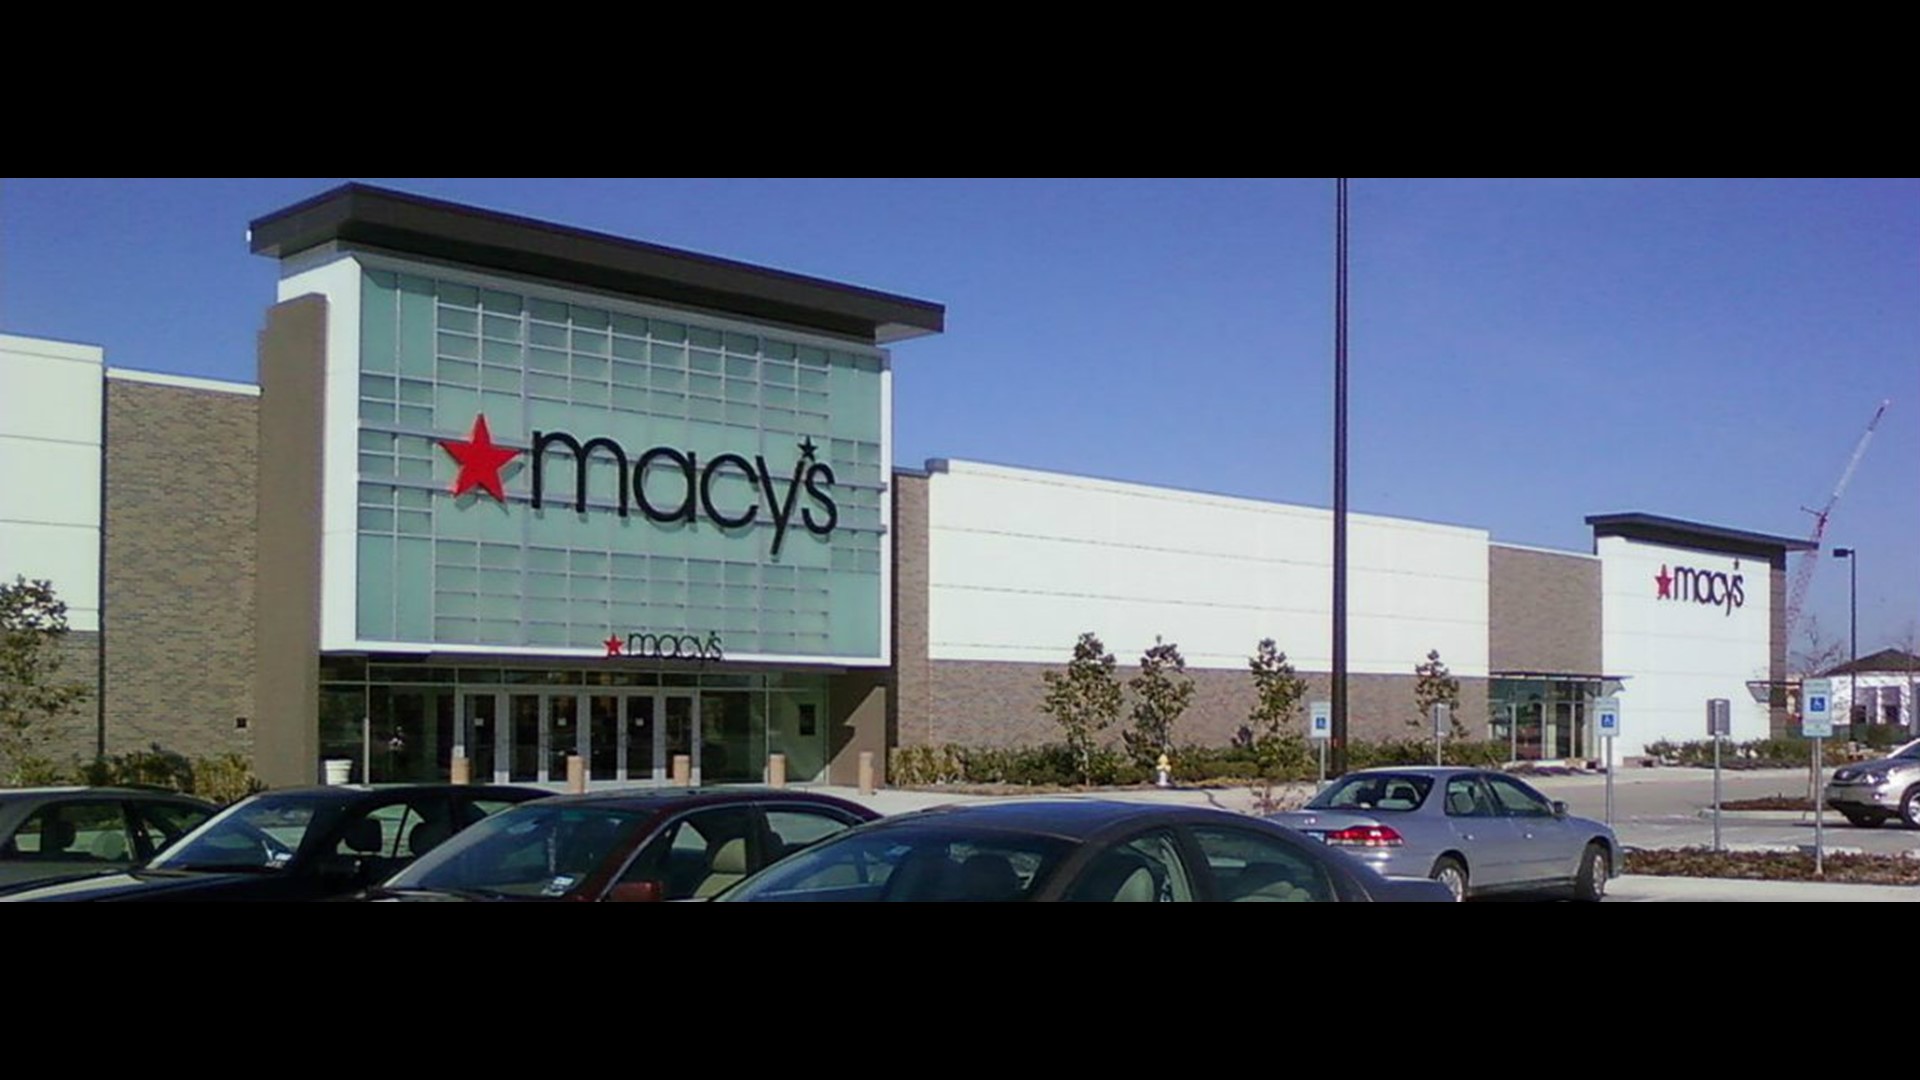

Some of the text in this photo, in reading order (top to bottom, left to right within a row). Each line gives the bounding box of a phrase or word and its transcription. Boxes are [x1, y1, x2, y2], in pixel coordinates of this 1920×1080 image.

[532, 431, 837, 554] macy's
[1674, 558, 1744, 616] macy's
[628, 631, 722, 664] macy's
